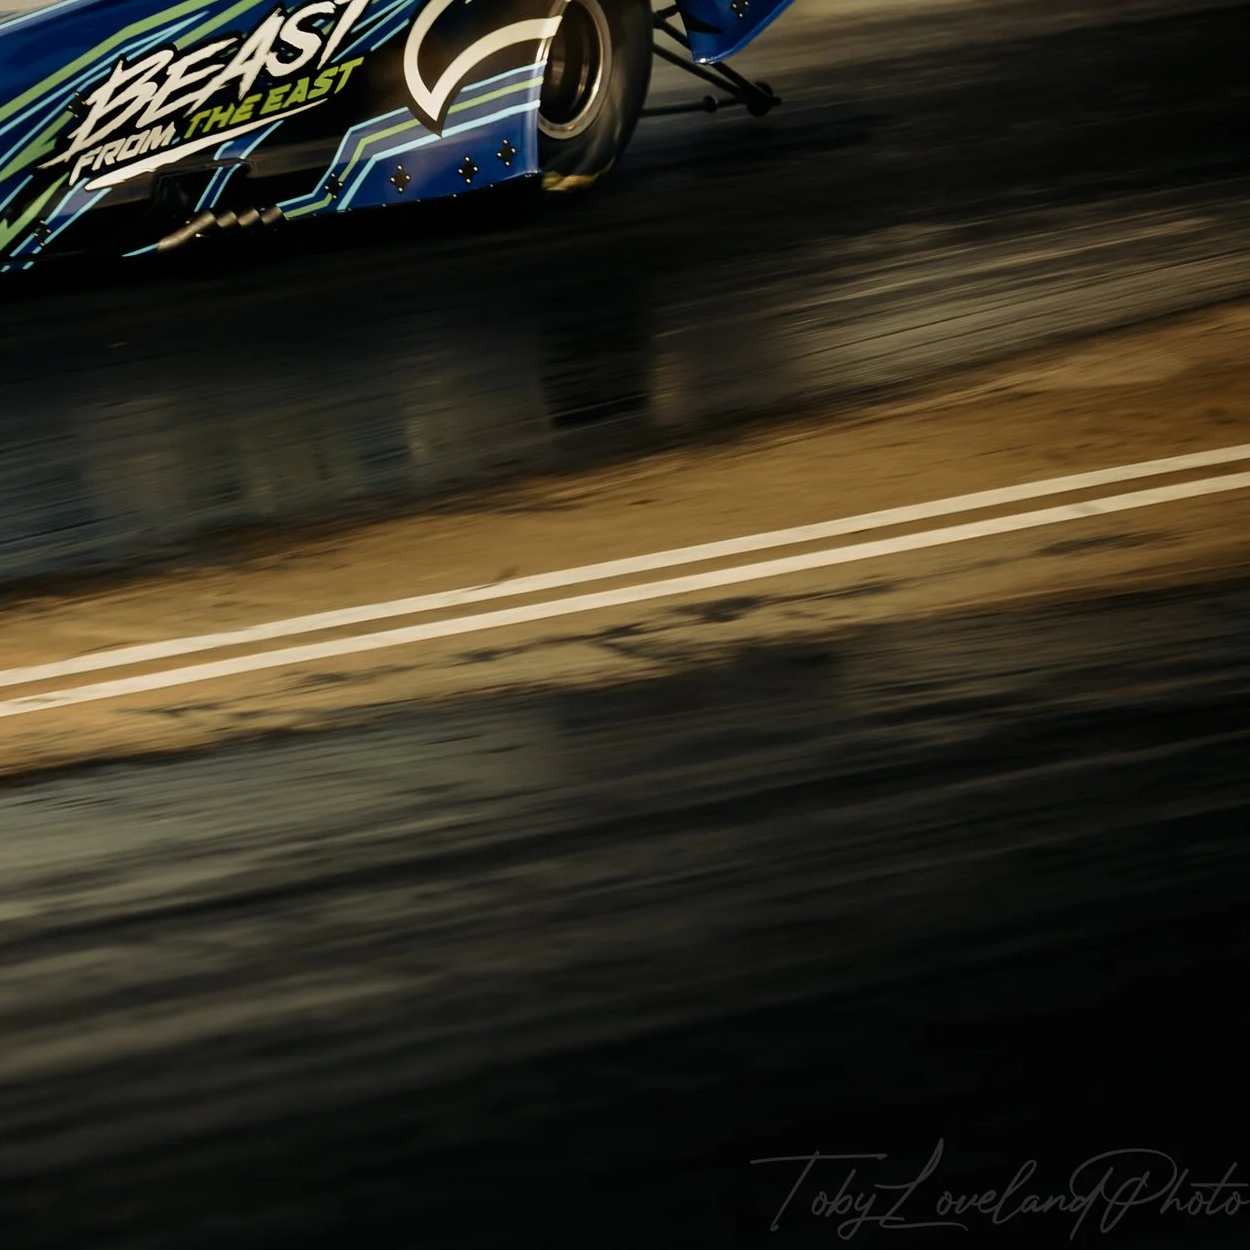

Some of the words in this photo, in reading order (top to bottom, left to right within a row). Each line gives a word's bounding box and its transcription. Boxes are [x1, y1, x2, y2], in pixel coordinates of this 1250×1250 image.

[69, 123, 178, 187] FROM
[183, 92, 263, 140] THE
[259, 56, 365, 116] EAST
